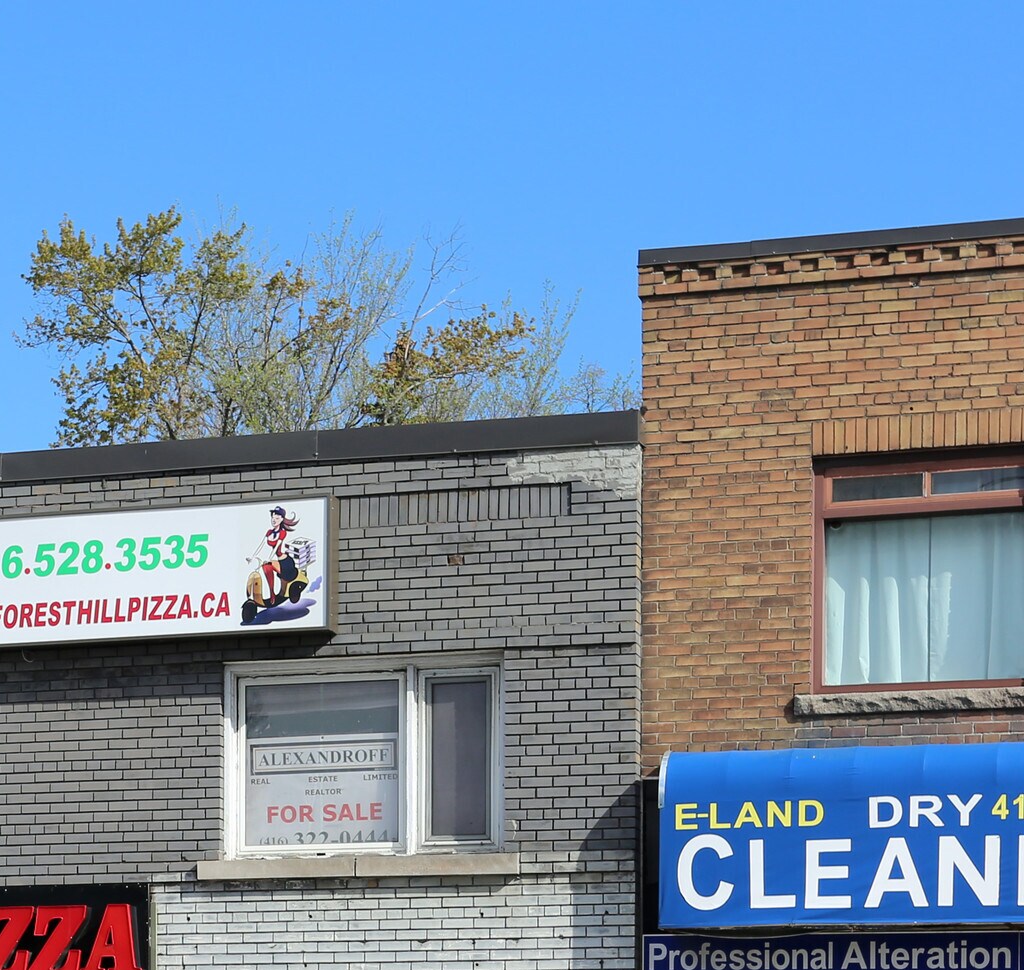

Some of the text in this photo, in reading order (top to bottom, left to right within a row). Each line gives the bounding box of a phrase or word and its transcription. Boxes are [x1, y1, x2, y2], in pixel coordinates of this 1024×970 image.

[258, 748, 389, 767] ALEXANDROFF
[308, 775, 338, 783] ESTATE
[363, 773, 398, 781] LIMITED
[304, 788, 342, 796] REALTOR
[267, 802, 383, 824] FOR SALE
[674, 799, 825, 831] E-LAND
[868, 793, 983, 829] DRY
[648, 940, 1012, 970] Professional Alteration
